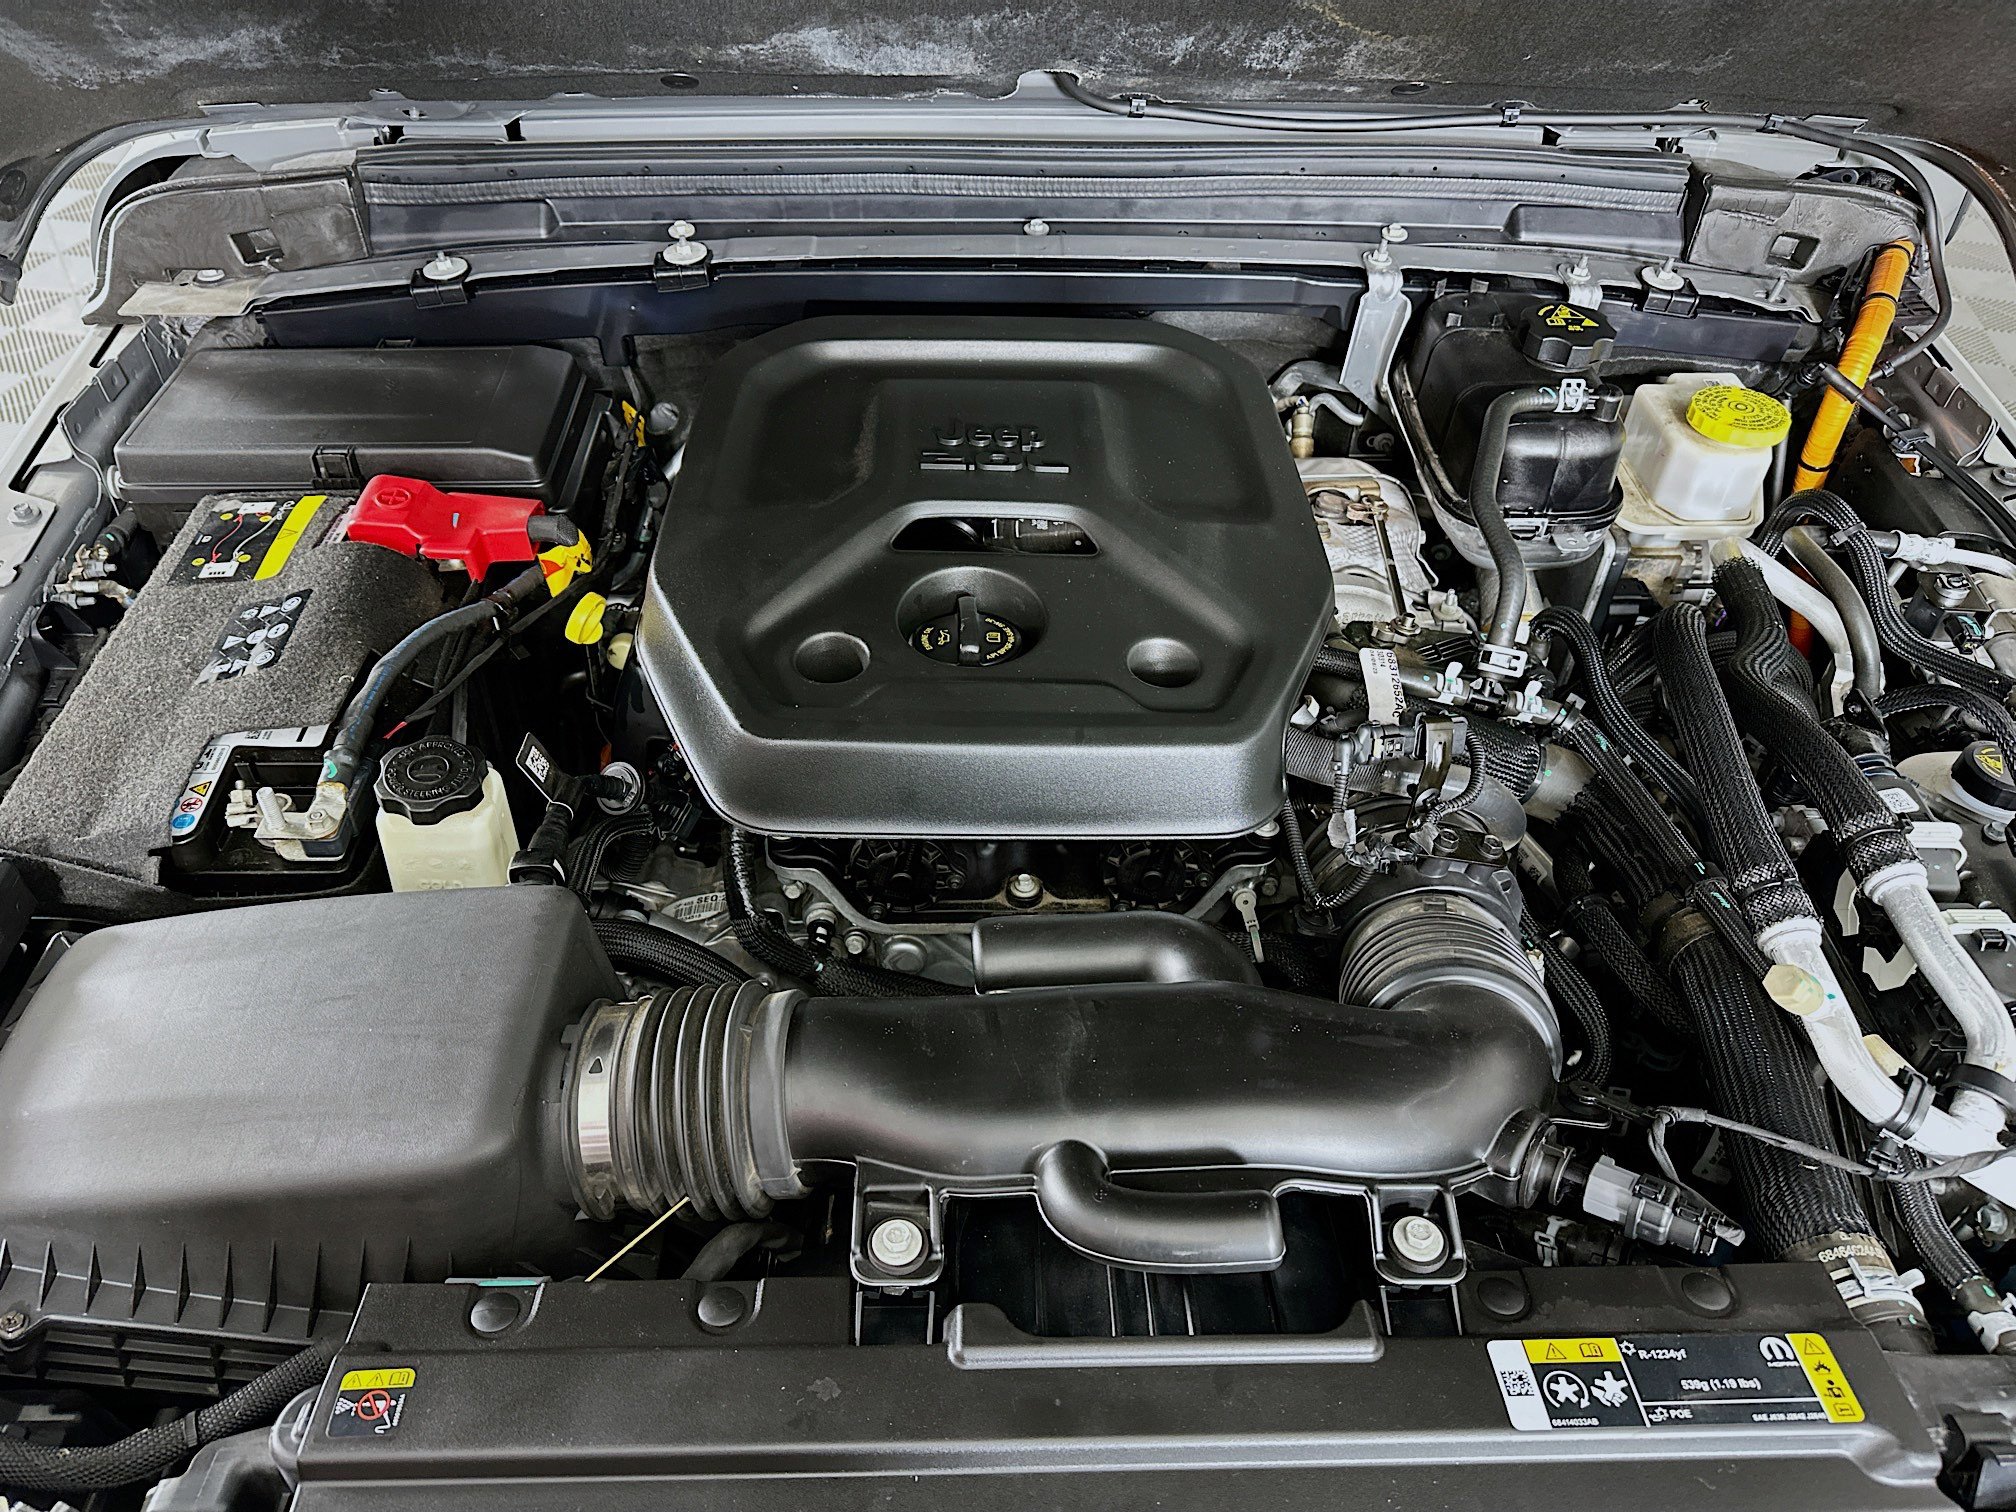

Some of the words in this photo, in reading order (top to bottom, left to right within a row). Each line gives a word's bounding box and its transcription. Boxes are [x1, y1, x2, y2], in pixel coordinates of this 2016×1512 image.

[937, 418, 1046, 452] Jeep
[1386, 651, 1404, 718] 68312652AC
[419, 740, 466, 758] APPROVED
[403, 784, 451, 799] STEERING
[1637, 1348, 1688, 1361] R-1234yf
[1680, 1378, 1710, 1392] 539g
[1710, 1378, 1737, 1392] (1.19
[1737, 1377, 1762, 1391] lbs)
[1669, 1409, 1694, 1419] POE
